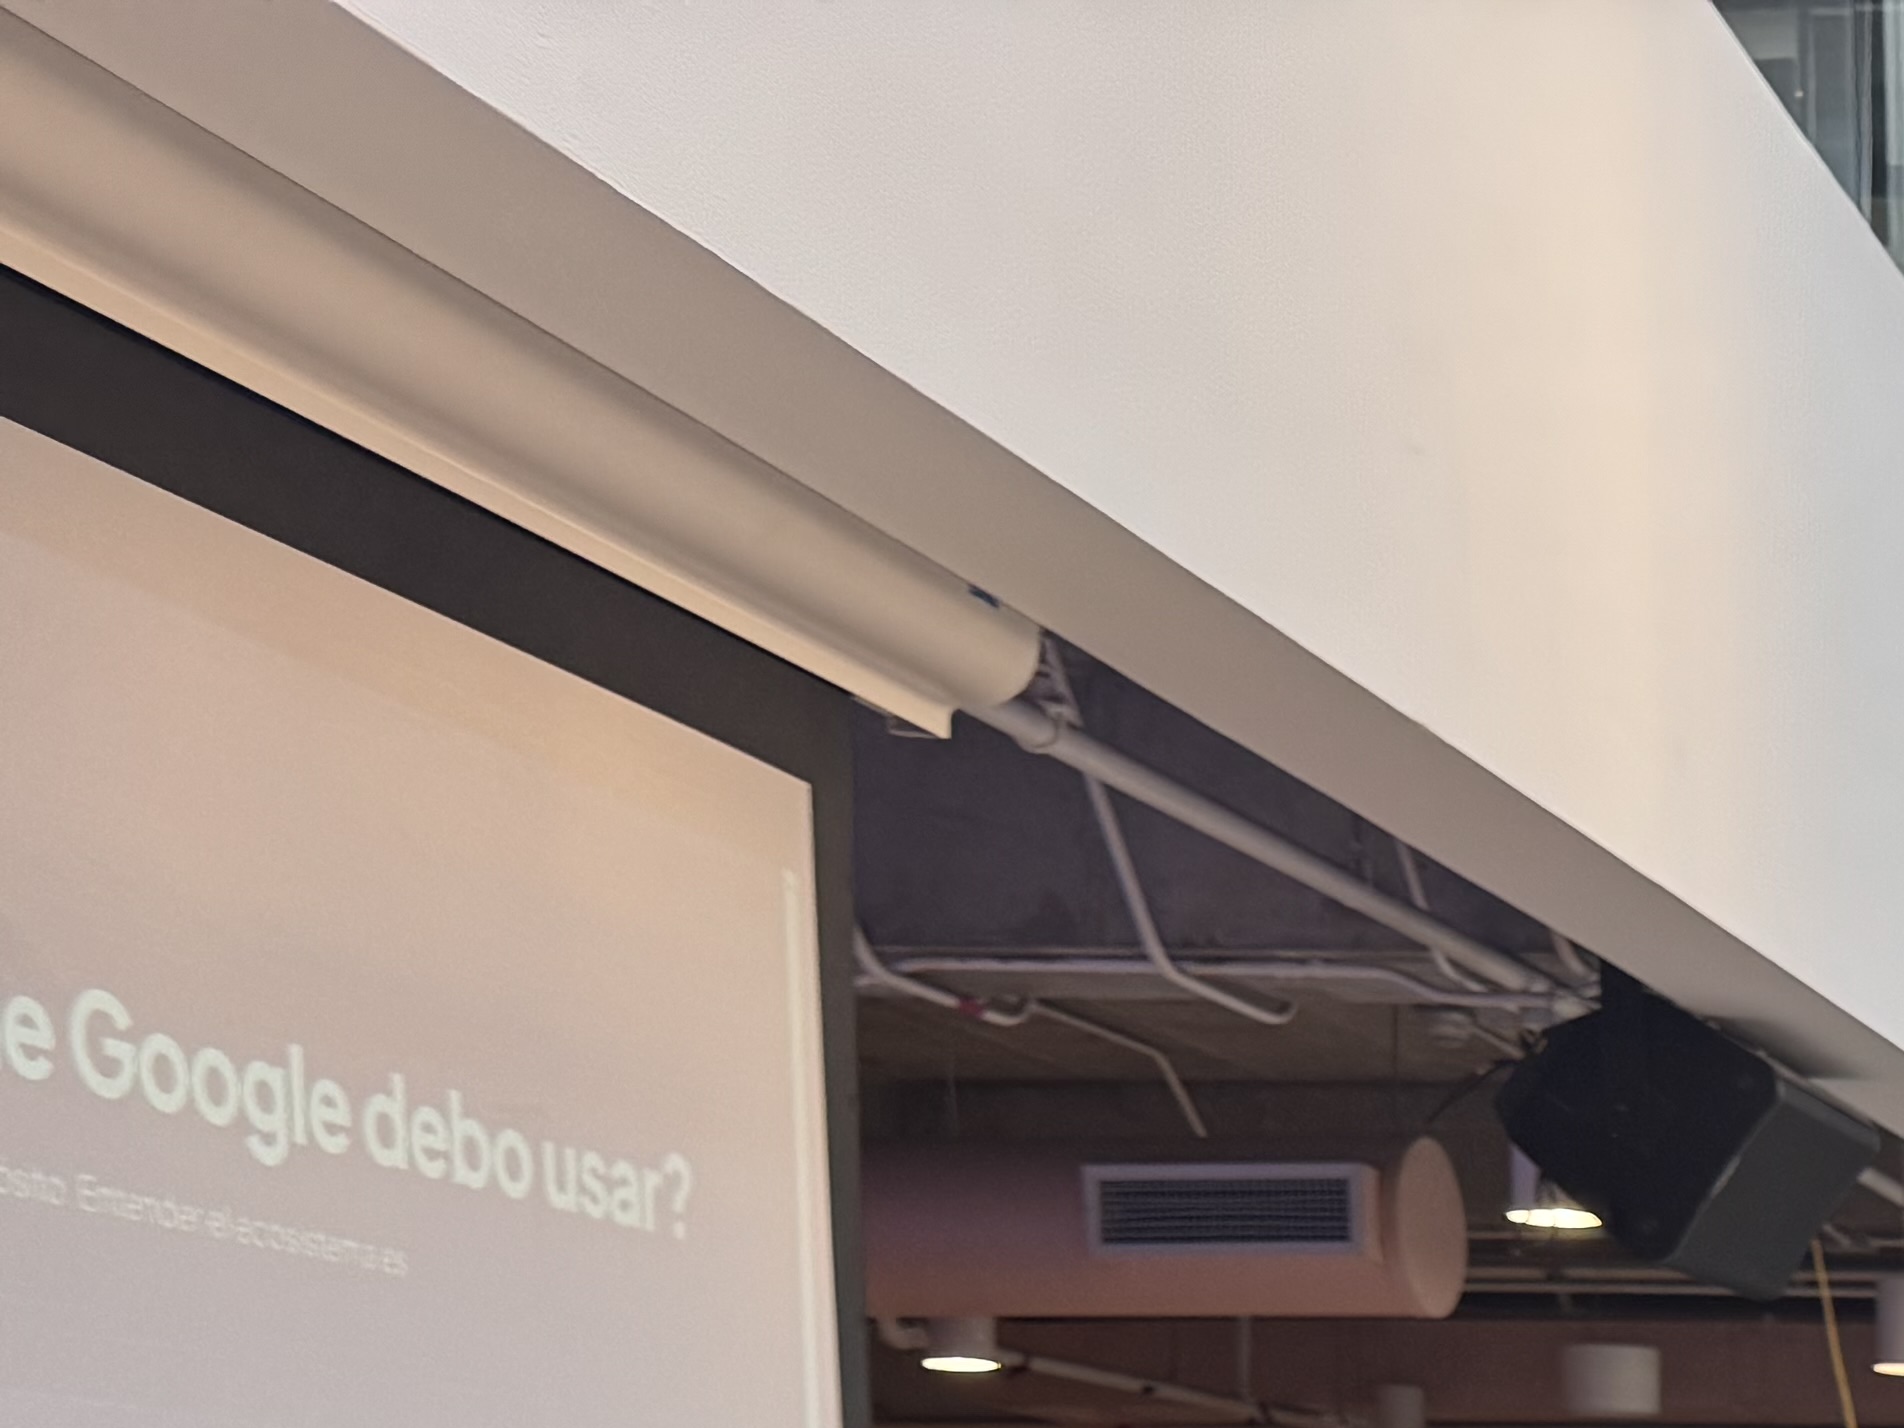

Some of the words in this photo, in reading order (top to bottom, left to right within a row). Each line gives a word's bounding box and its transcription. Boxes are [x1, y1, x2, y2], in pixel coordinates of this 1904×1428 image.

[0, 994, 56, 1082] e
[68, 988, 352, 1168] Google
[362, 1072, 535, 1201] debo
[541, 1140, 693, 1242] usar?
